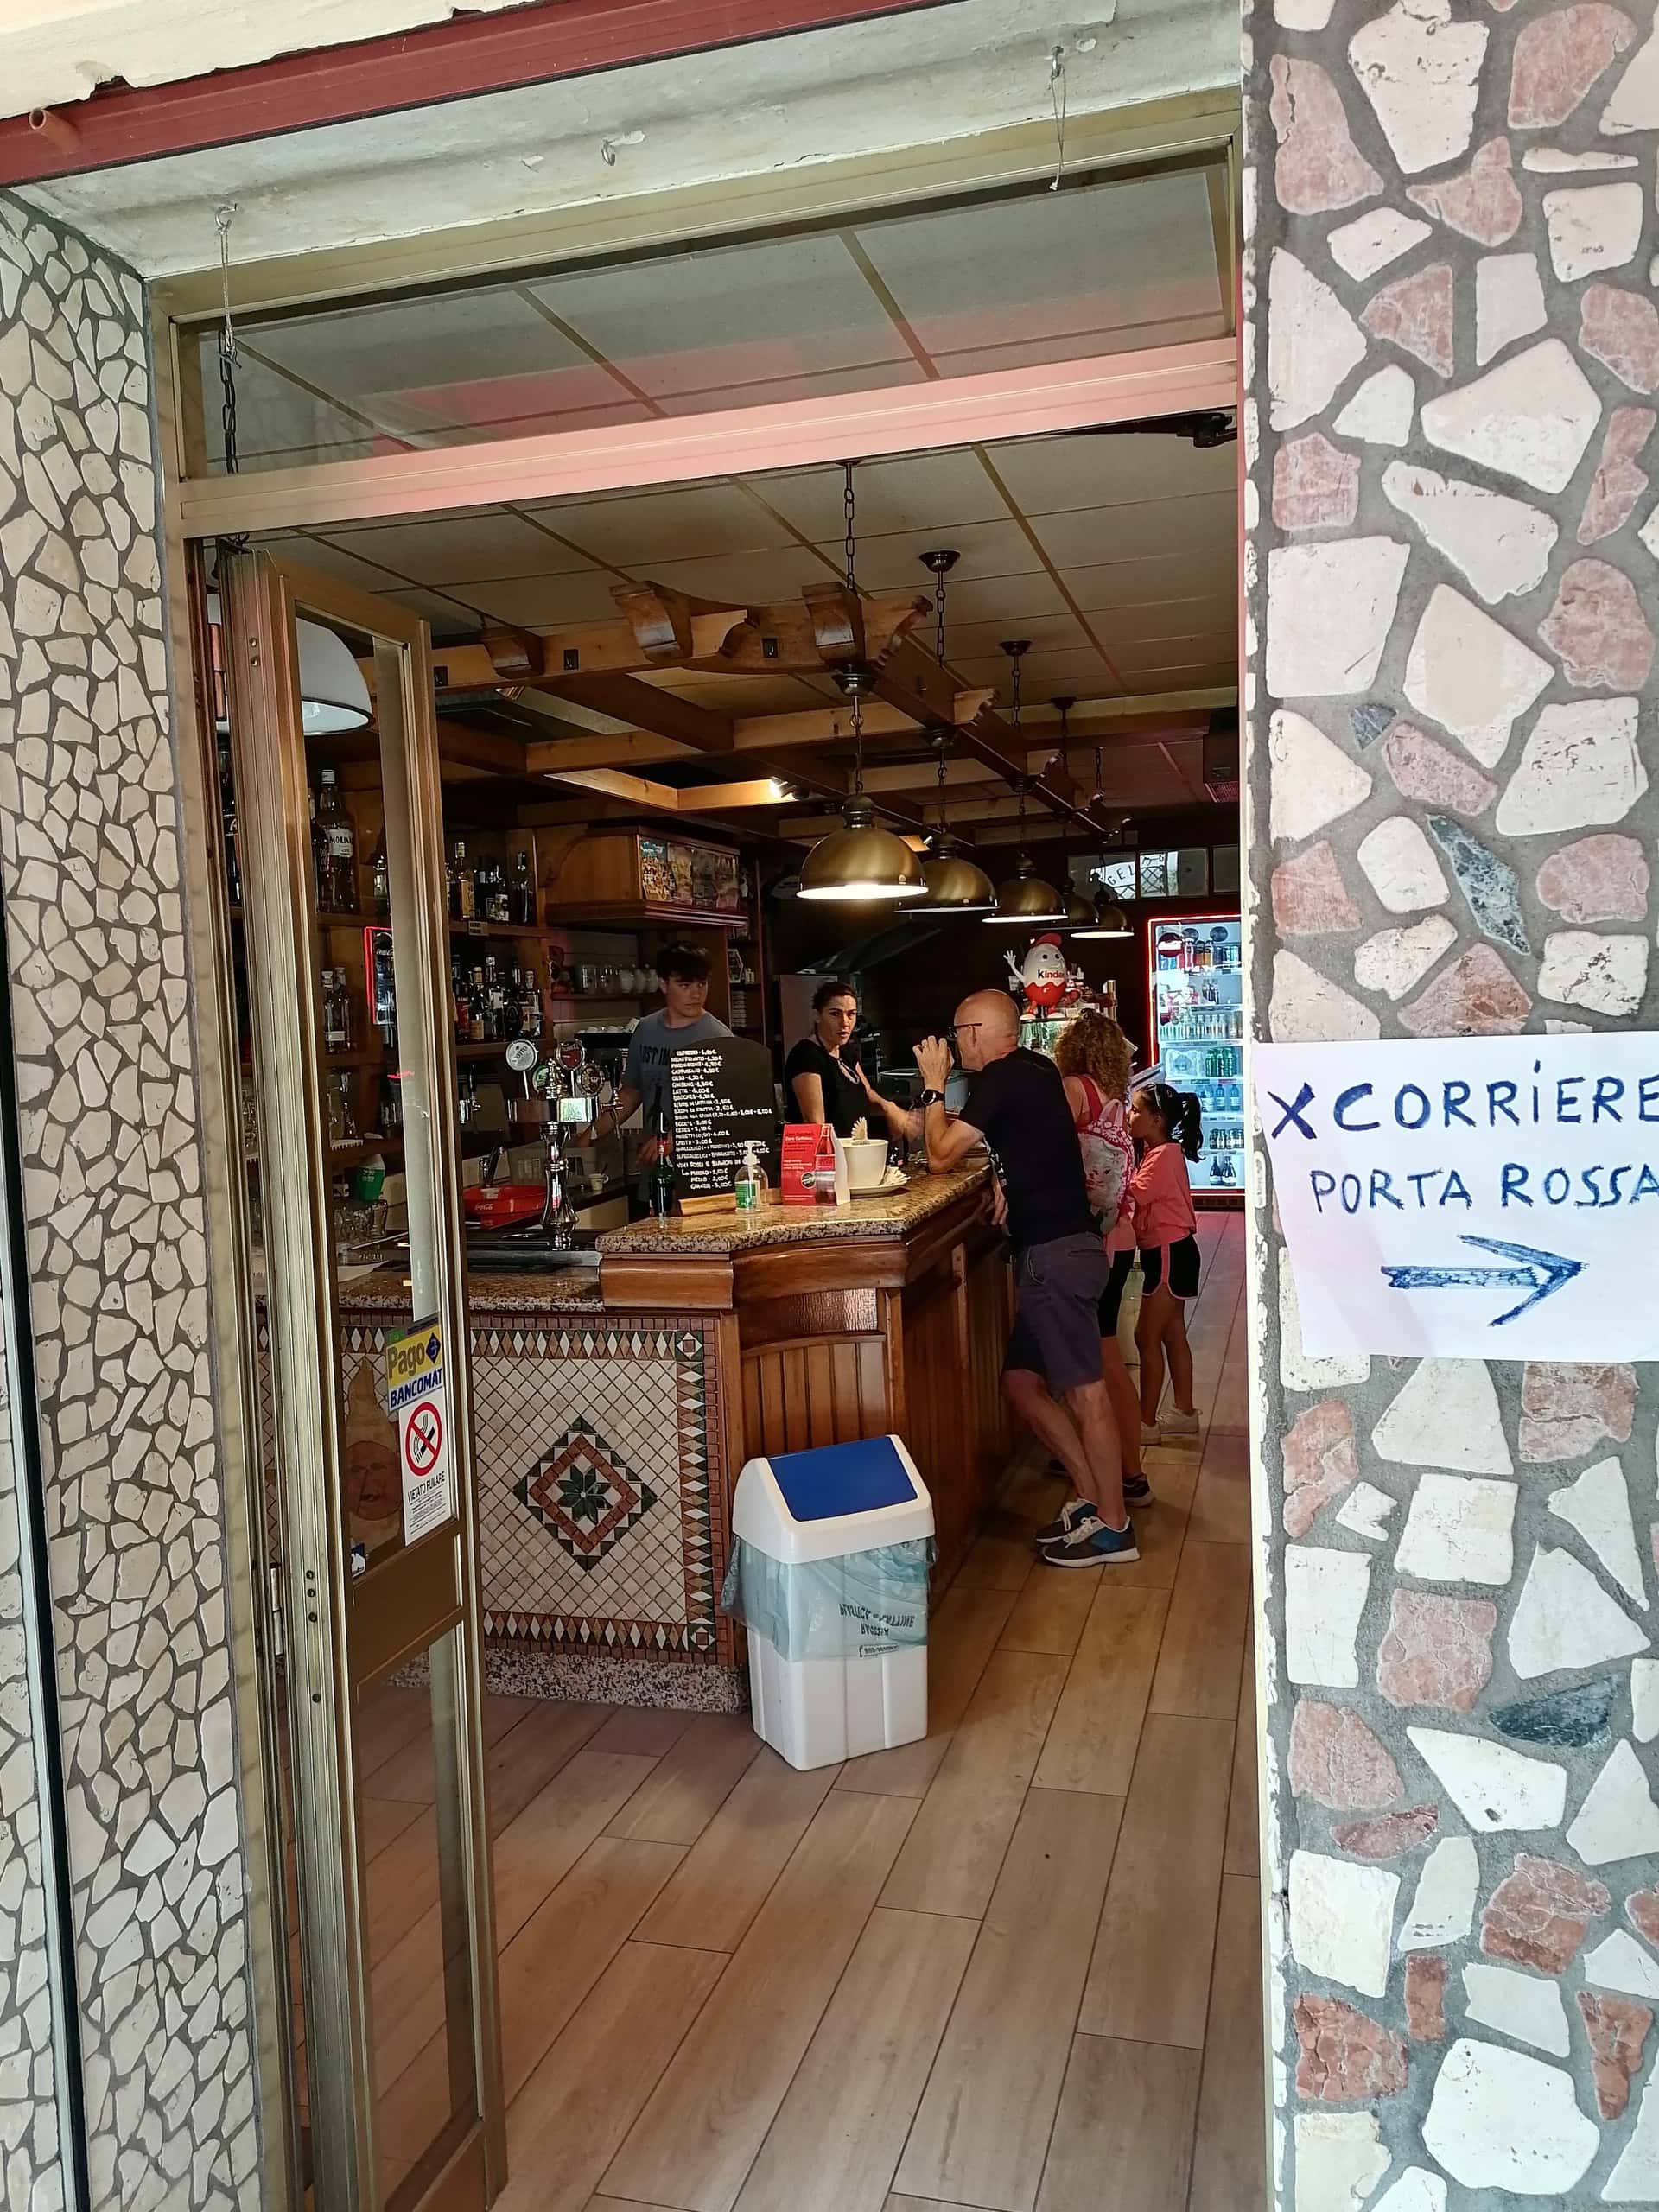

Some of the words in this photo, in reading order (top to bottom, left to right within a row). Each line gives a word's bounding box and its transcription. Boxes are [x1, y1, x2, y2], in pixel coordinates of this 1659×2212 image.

[1309, 1168, 1472, 1214] PORTA
[1500, 1162, 1659, 1209] ROSSA
[387, 1342, 425, 1379] Pago
[390, 1367, 442, 1408] BANCOMAT
[407, 1483, 426, 1503] VIETATO
[426, 1471, 445, 1492] FUMARE
